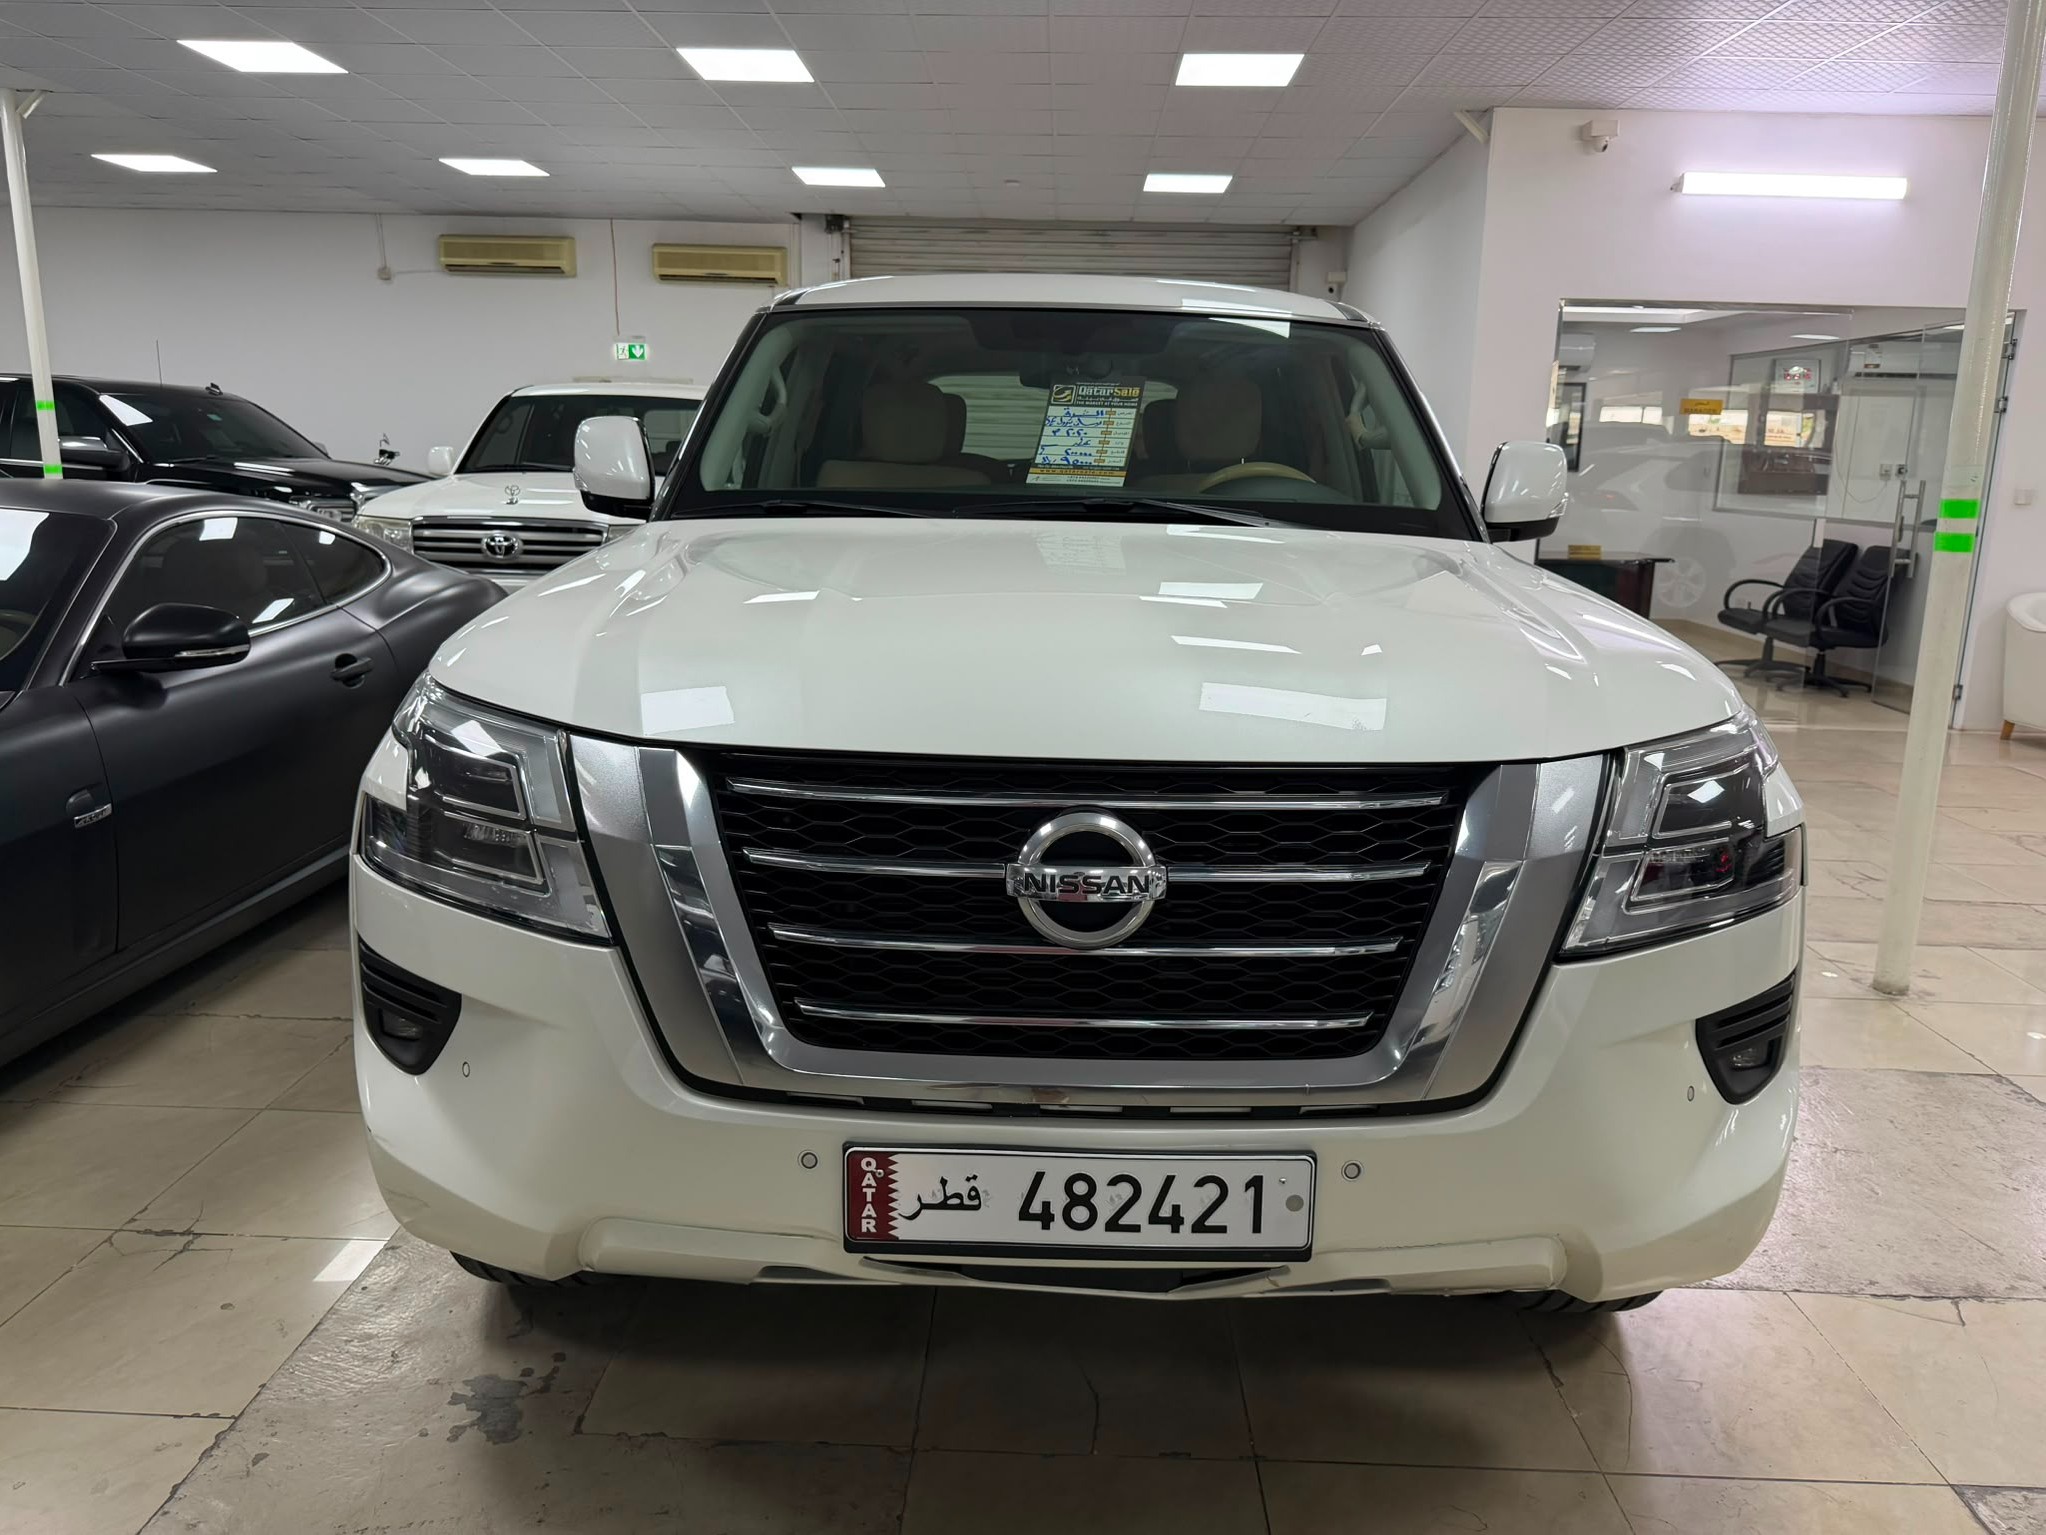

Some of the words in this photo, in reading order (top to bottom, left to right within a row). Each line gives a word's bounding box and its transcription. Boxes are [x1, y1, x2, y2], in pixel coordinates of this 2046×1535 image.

[1078, 385, 1141, 397] QatarSale
[1024, 872, 1149, 894] NISSAN
[861, 1157, 878, 1233] QATAR
[898, 1174, 982, 1221] قطر
[1018, 1171, 1264, 1234] 482421
